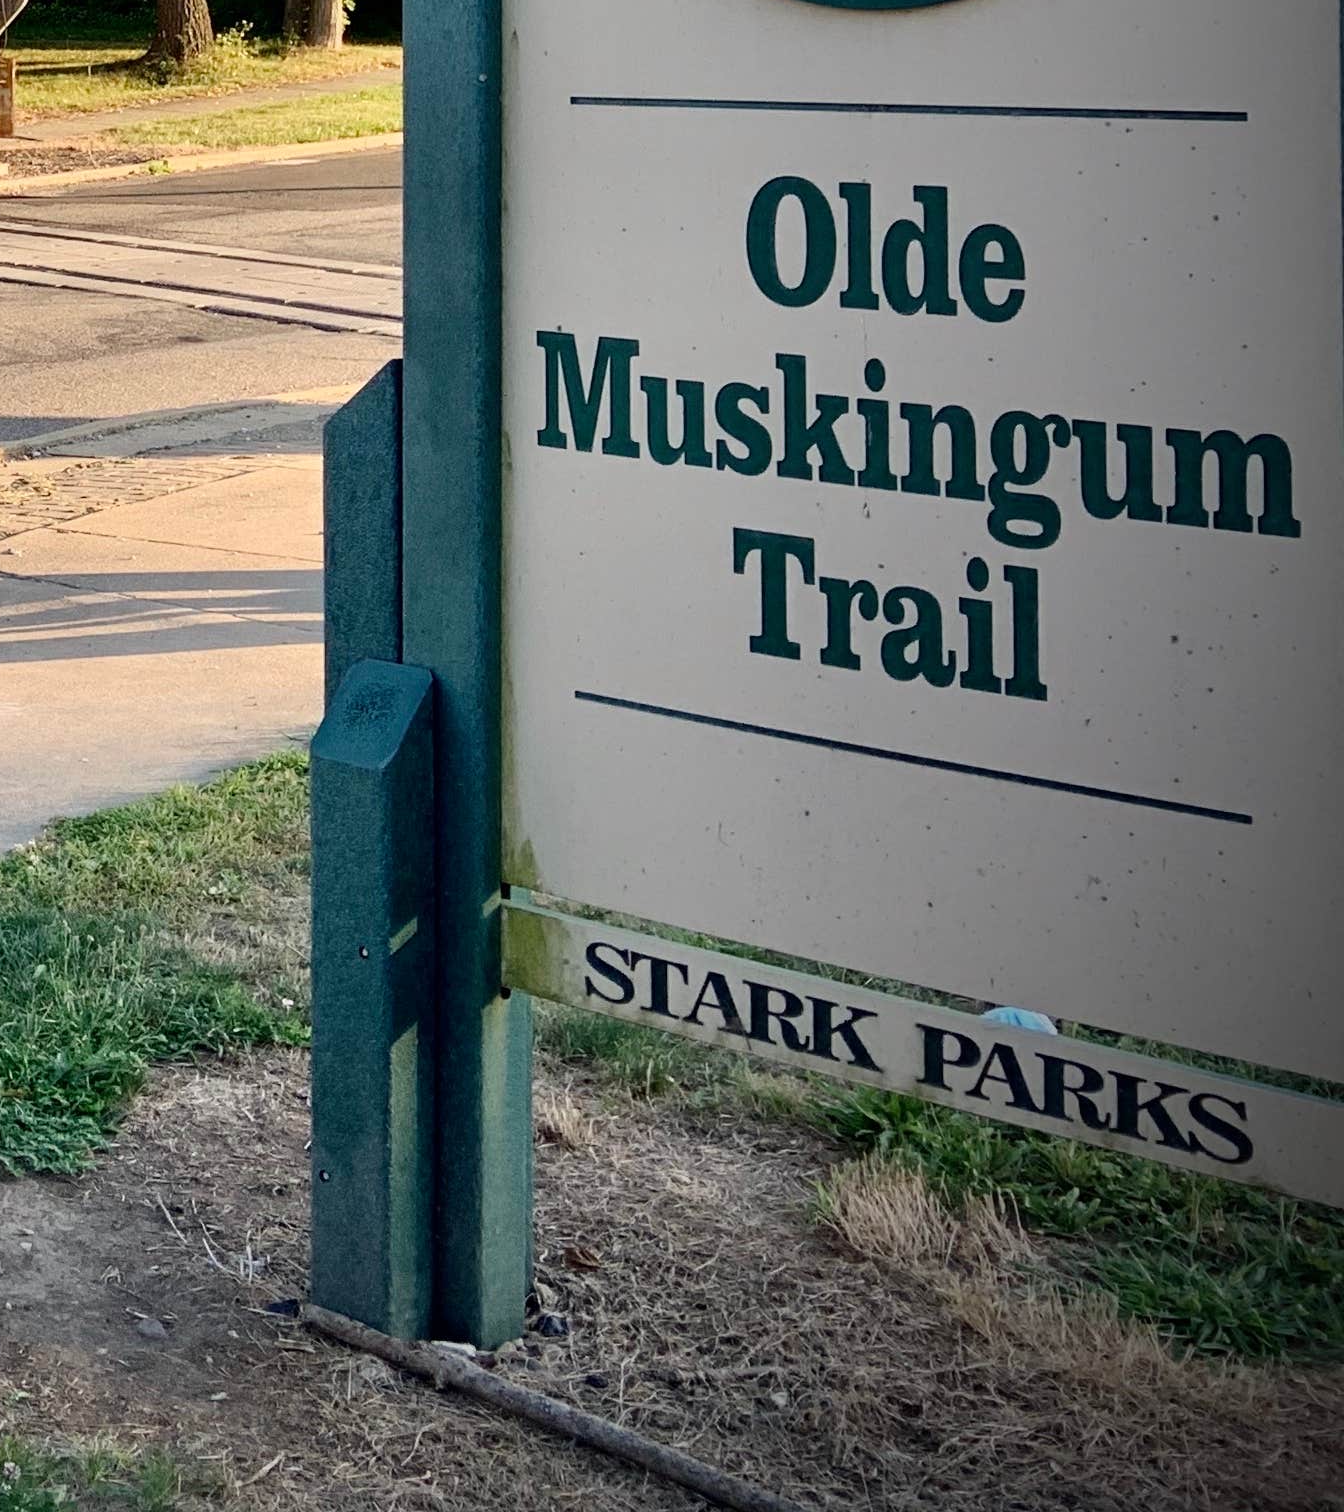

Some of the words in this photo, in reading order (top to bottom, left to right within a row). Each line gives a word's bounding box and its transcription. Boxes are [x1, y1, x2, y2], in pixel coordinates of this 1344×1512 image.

[745, 175, 1027, 323] Olde
[535, 330, 1303, 549] Muskingum
[732, 527, 1048, 702] Trail
[584, 940, 883, 1073] STARK
[914, 1022, 1255, 1166] PARKS
